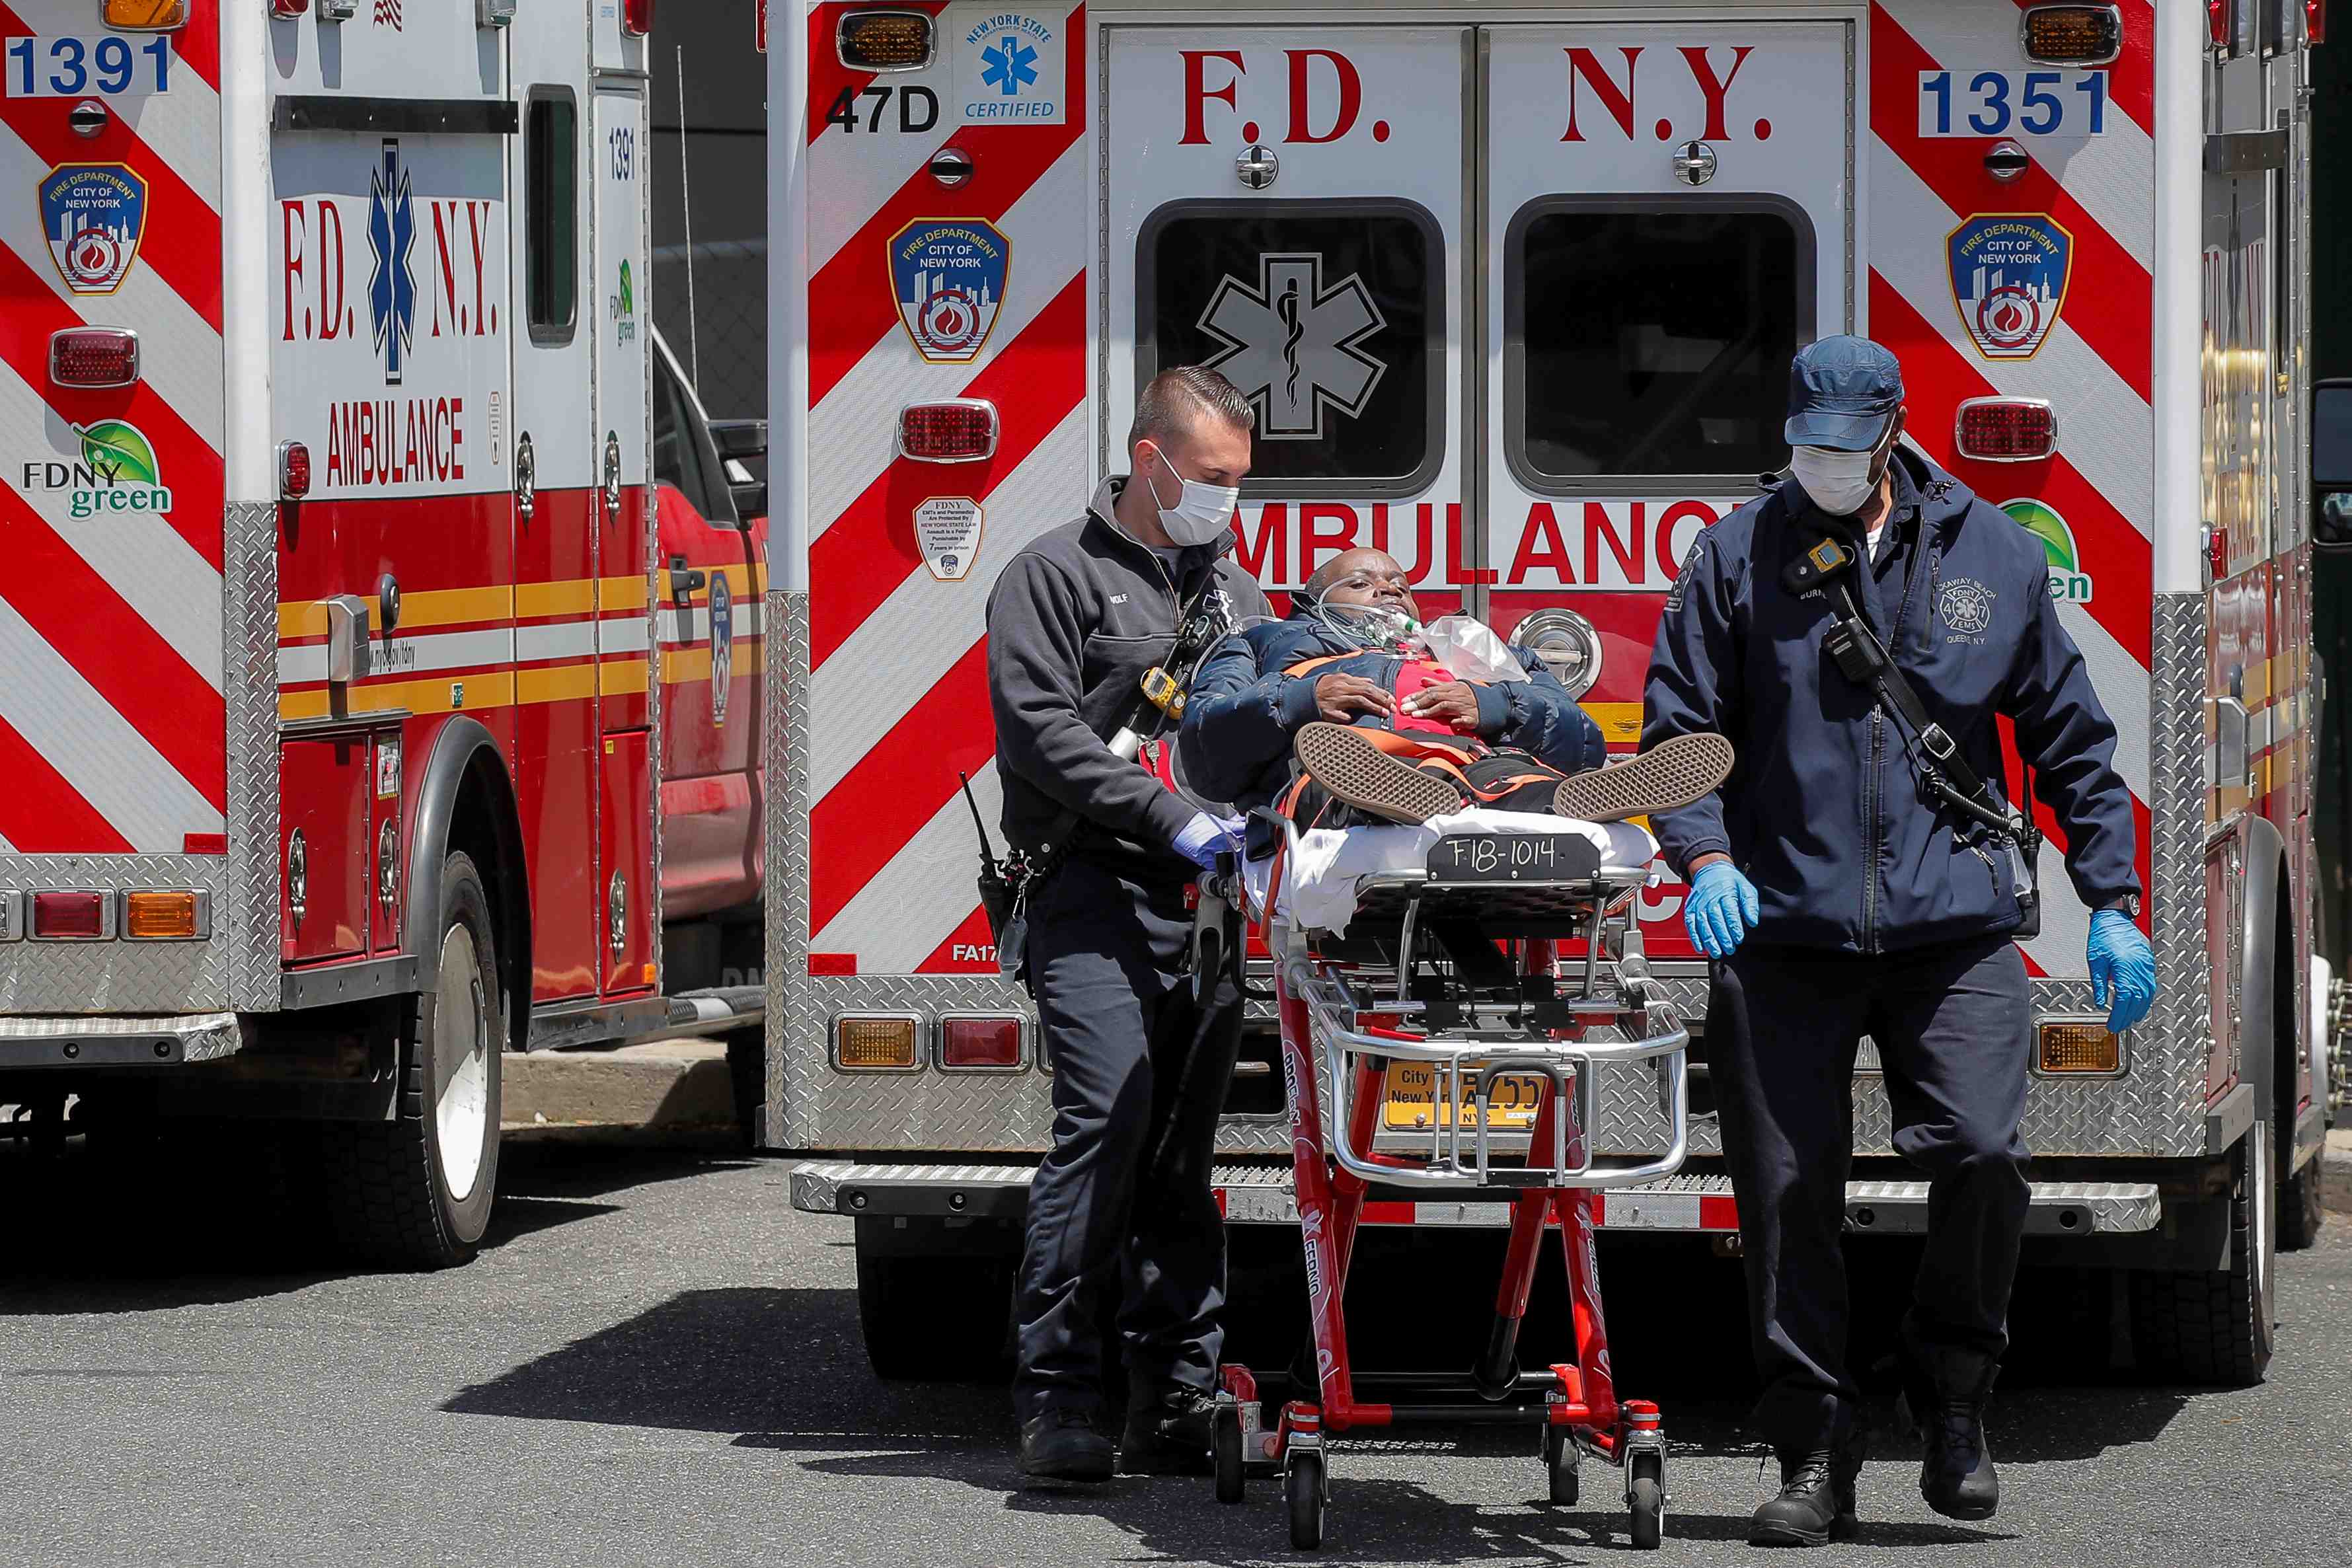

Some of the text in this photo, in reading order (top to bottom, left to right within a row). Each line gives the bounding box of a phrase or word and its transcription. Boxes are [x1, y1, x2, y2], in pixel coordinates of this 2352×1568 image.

[966, 15, 1052, 44] NEW YORK STATE
[9, 37, 169, 94] 1391
[1177, 46, 1773, 145] F.D. N.Y.
[1922, 71, 2104, 135] 1351
[825, 86, 939, 133] 47D
[965, 102, 1054, 117] CERTIFIED
[609, 128, 635, 180] 1391
[50, 172, 137, 202] FIRE DEPARTMENT
[73, 188, 113, 197] CITY OF
[65, 199, 121, 208] NEW YORK
[902, 228, 999, 260] FIRE DEPARTMENT
[929, 245, 973, 255] CITY OF
[1961, 224, 2059, 256] FIRE DEPARTMENT
[1987, 241, 2033, 250] CITY OF
[282, 200, 497, 341] F.D. N.Y.
[920, 258, 981, 268] NEW YORK
[1978, 254, 2041, 264] NEW YORK
[610, 295, 628, 321] FDNY
[326, 396, 463, 487] AMBULANCE
[23, 462, 123, 488] FDNY
[70, 489, 169, 518] green
[1227, 500, 1746, 585] MBULANC
[1939, 578, 1971, 591] CKAWAY
[1943, 603, 1952, 615] 4
[1979, 605, 1987, 618] 7
[1958, 621, 1975, 630] EMS
[1445, 837, 1556, 872] F18-1014
[1401, 1070, 1429, 1086] City
[1391, 1090, 1422, 1103] New
